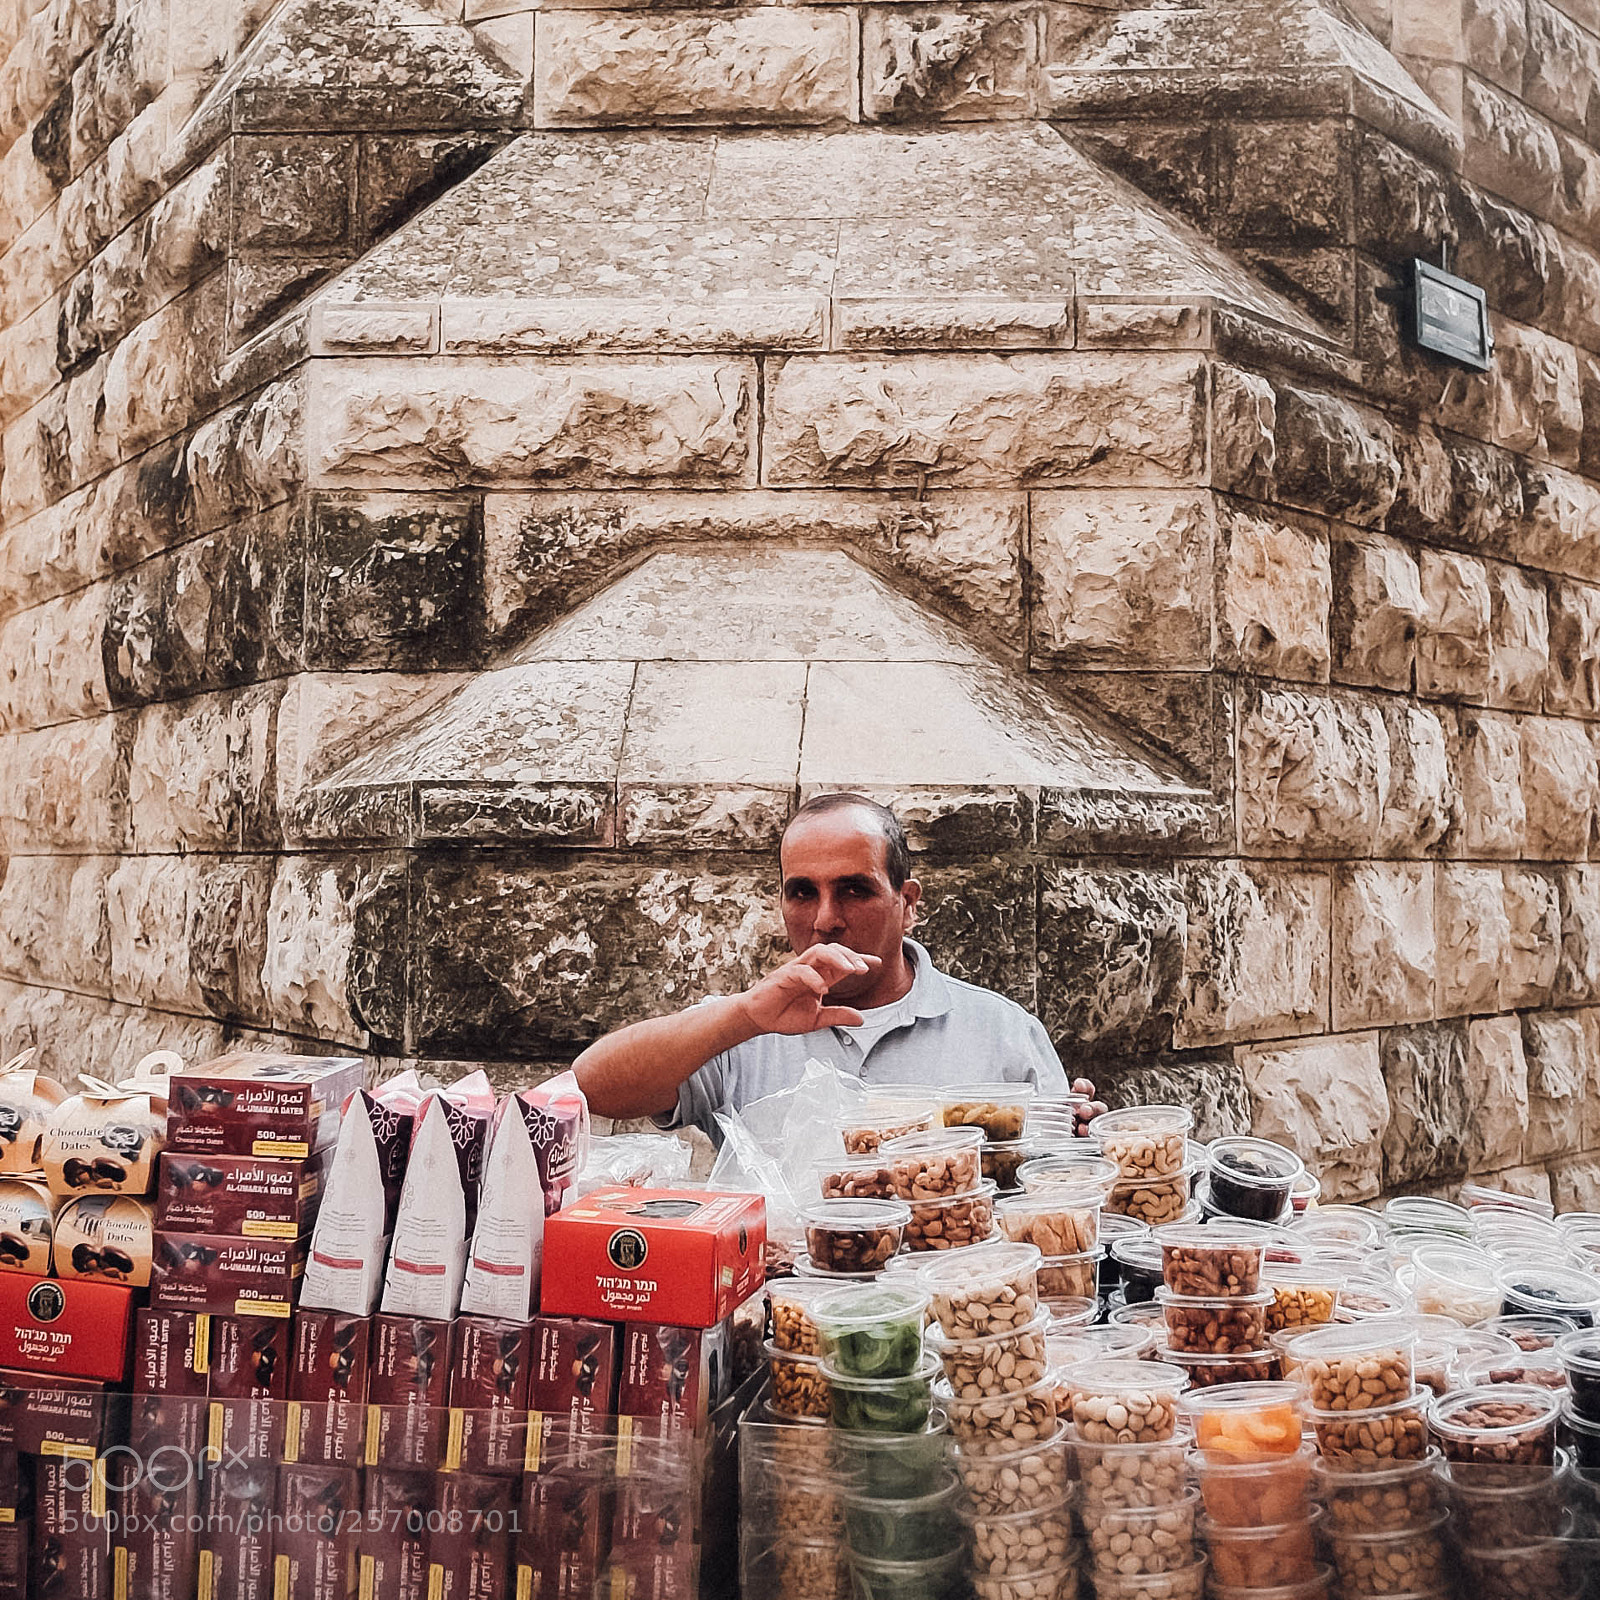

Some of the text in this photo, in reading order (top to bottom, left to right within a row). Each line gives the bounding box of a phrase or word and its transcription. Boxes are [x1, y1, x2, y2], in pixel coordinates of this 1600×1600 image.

[50, 1128, 104, 1136] Chocolate
[257, 1131, 275, 1139] 500
[61, 1142, 91, 1150] Dates
[247, 1210, 265, 1219] 500
[107, 1232, 134, 1241] Dates
[634, 1280, 657, 1291] תמר
[240, 1290, 258, 1299] 500
[50, 1332, 72, 1345] תמר
[184, 1348, 193, 1368] 500
[301, 1409, 310, 1428] 500
